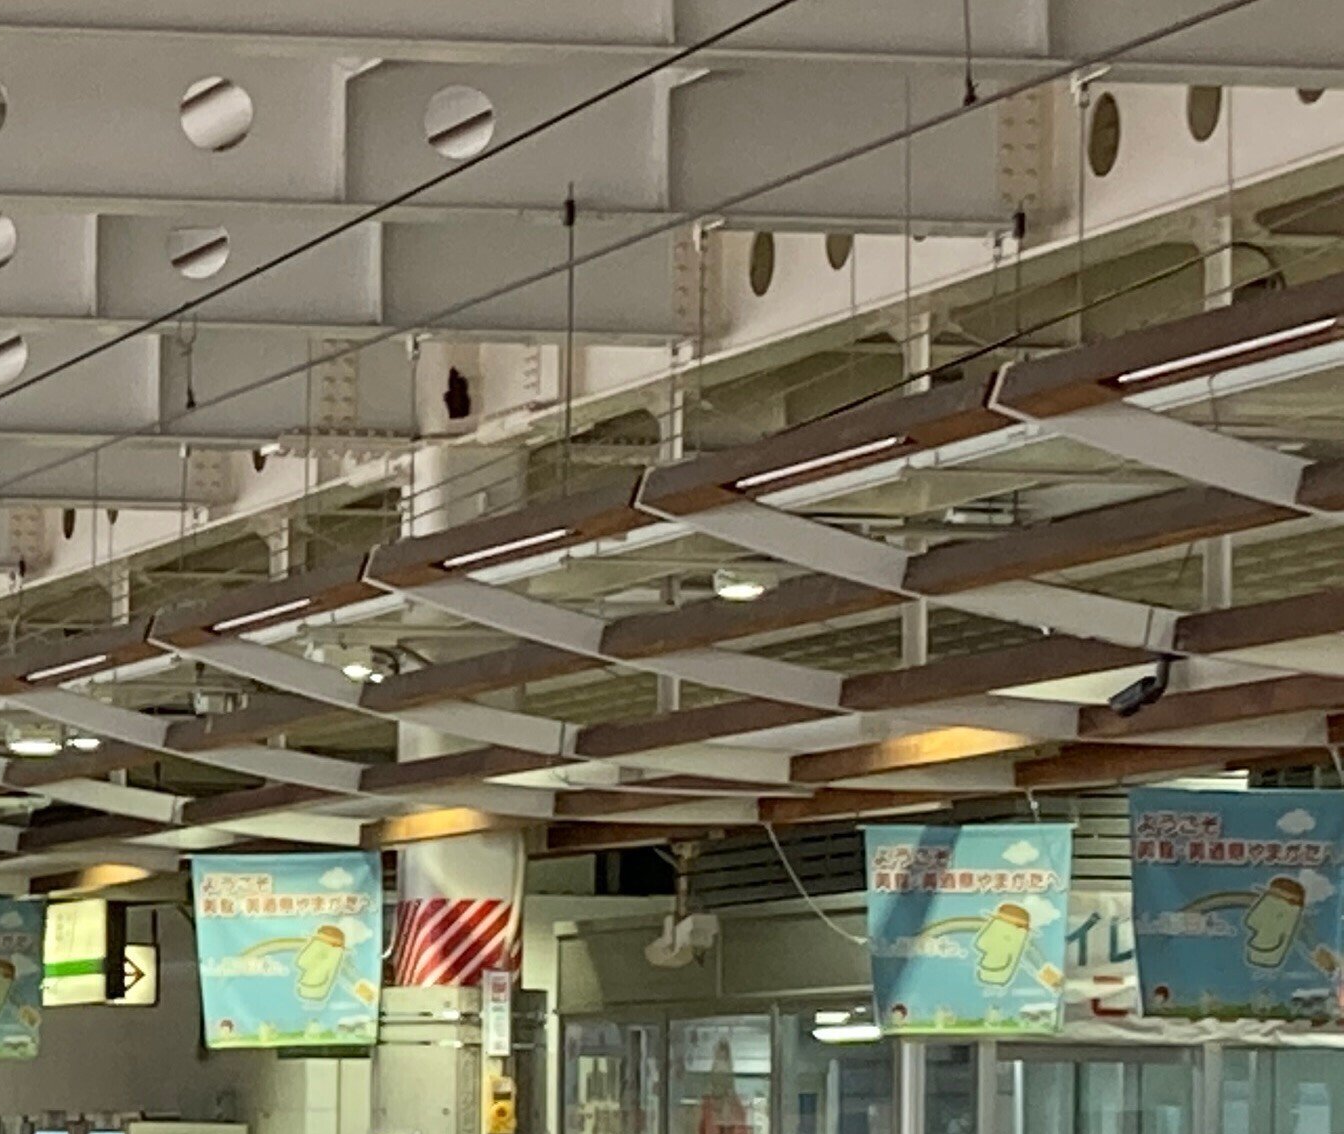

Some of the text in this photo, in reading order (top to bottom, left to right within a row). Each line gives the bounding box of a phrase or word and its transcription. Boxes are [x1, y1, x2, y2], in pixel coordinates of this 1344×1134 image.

[1137, 814, 1219, 836] ようこそ
[874, 847, 950, 868] ようこそ
